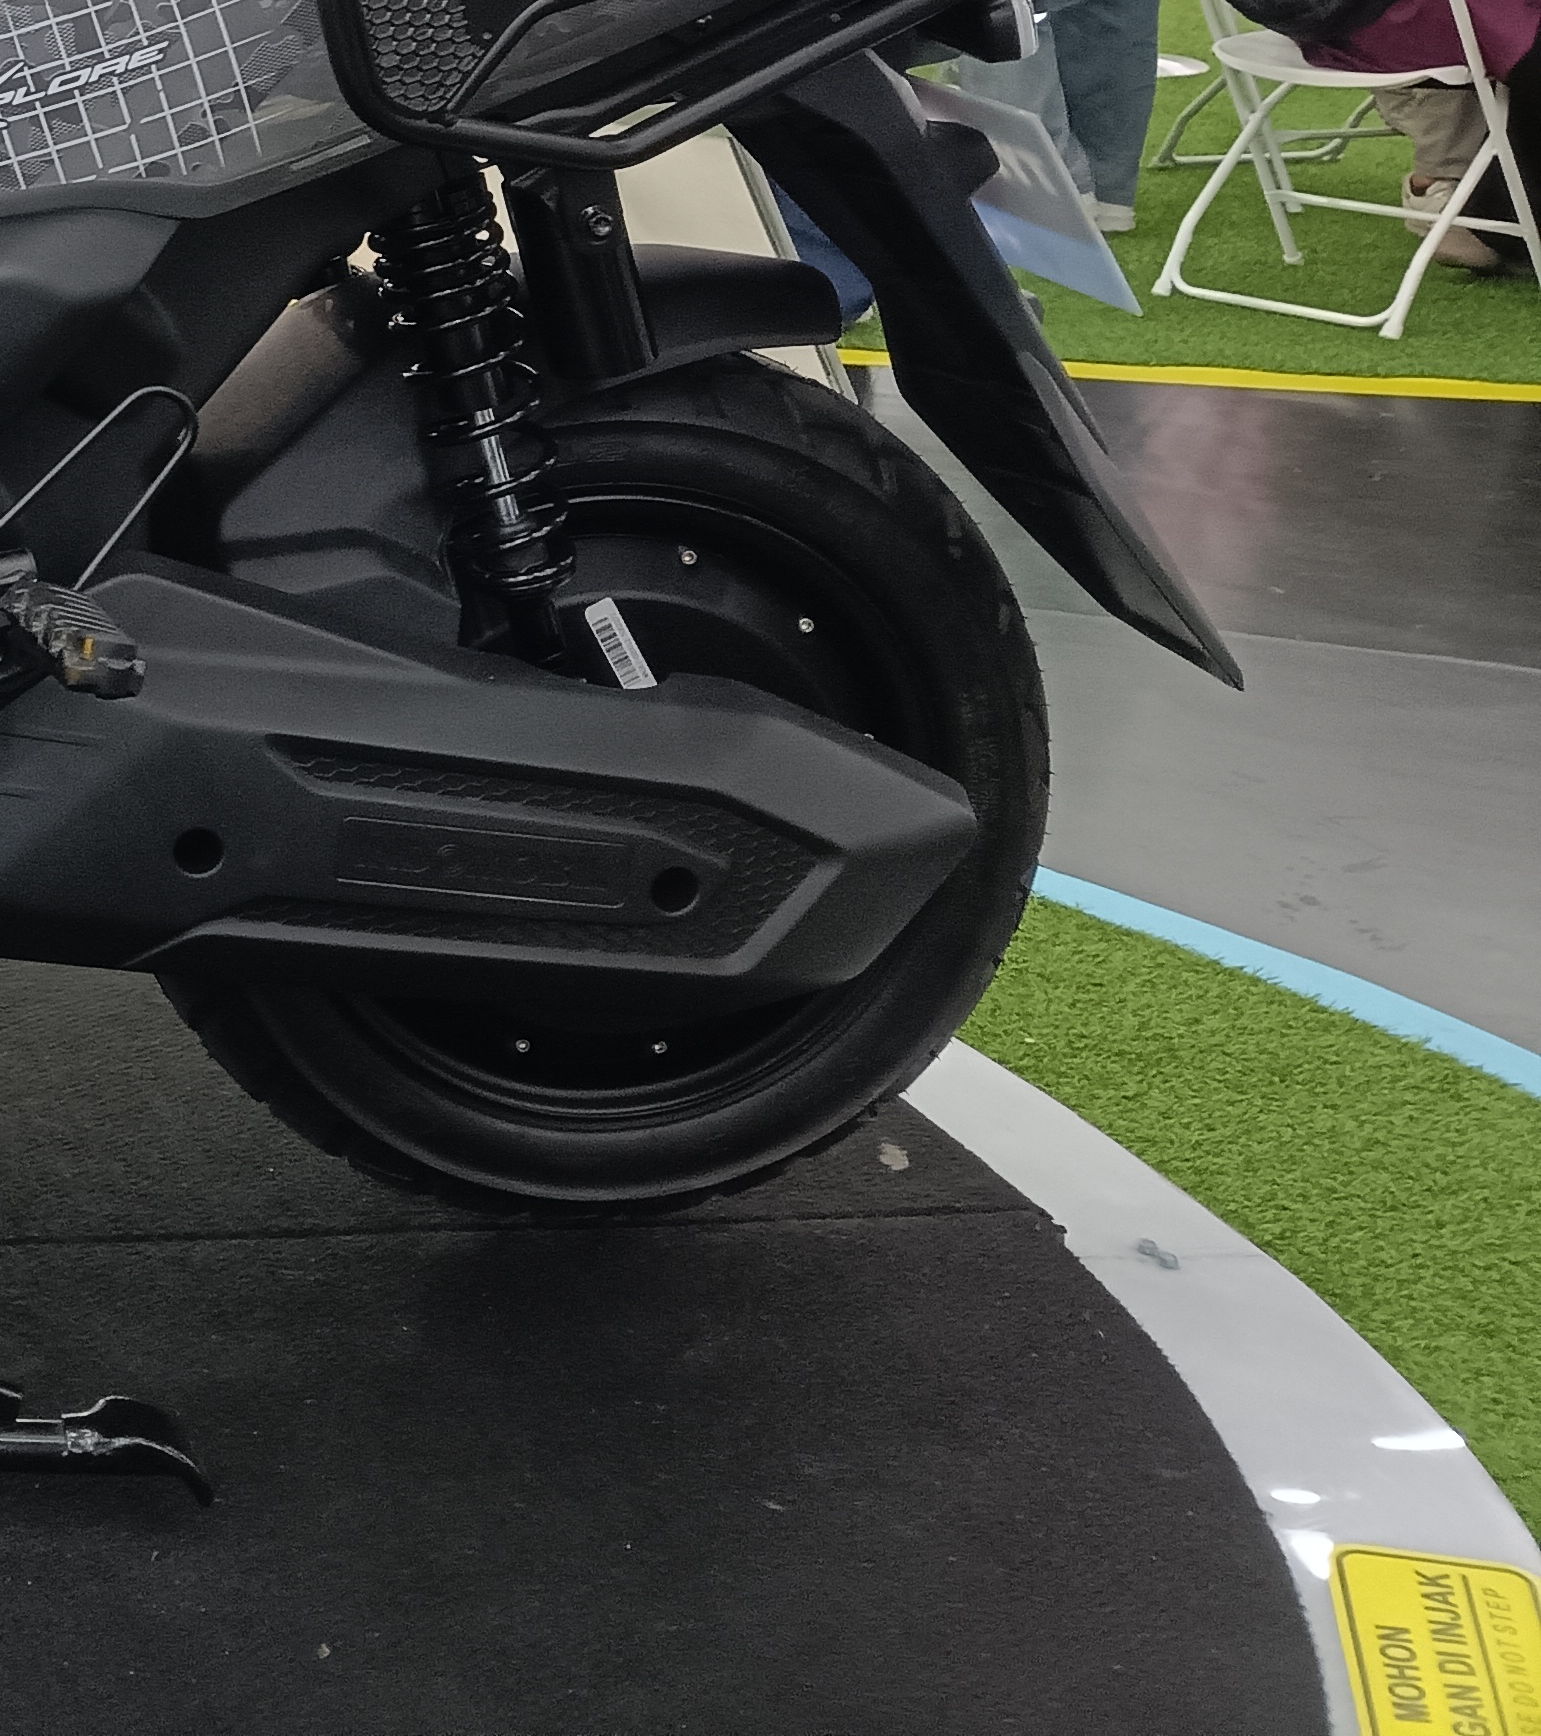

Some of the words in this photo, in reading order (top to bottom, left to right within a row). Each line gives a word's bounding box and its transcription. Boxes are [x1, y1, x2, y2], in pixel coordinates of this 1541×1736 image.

[1414, 1569, 1469, 1646] INJAK
[1481, 1587, 1519, 1636] STEP
[1374, 1624, 1434, 1724] MOHON
[1435, 1650, 1477, 1678] DI
[1495, 1639, 1527, 1676] NOT
